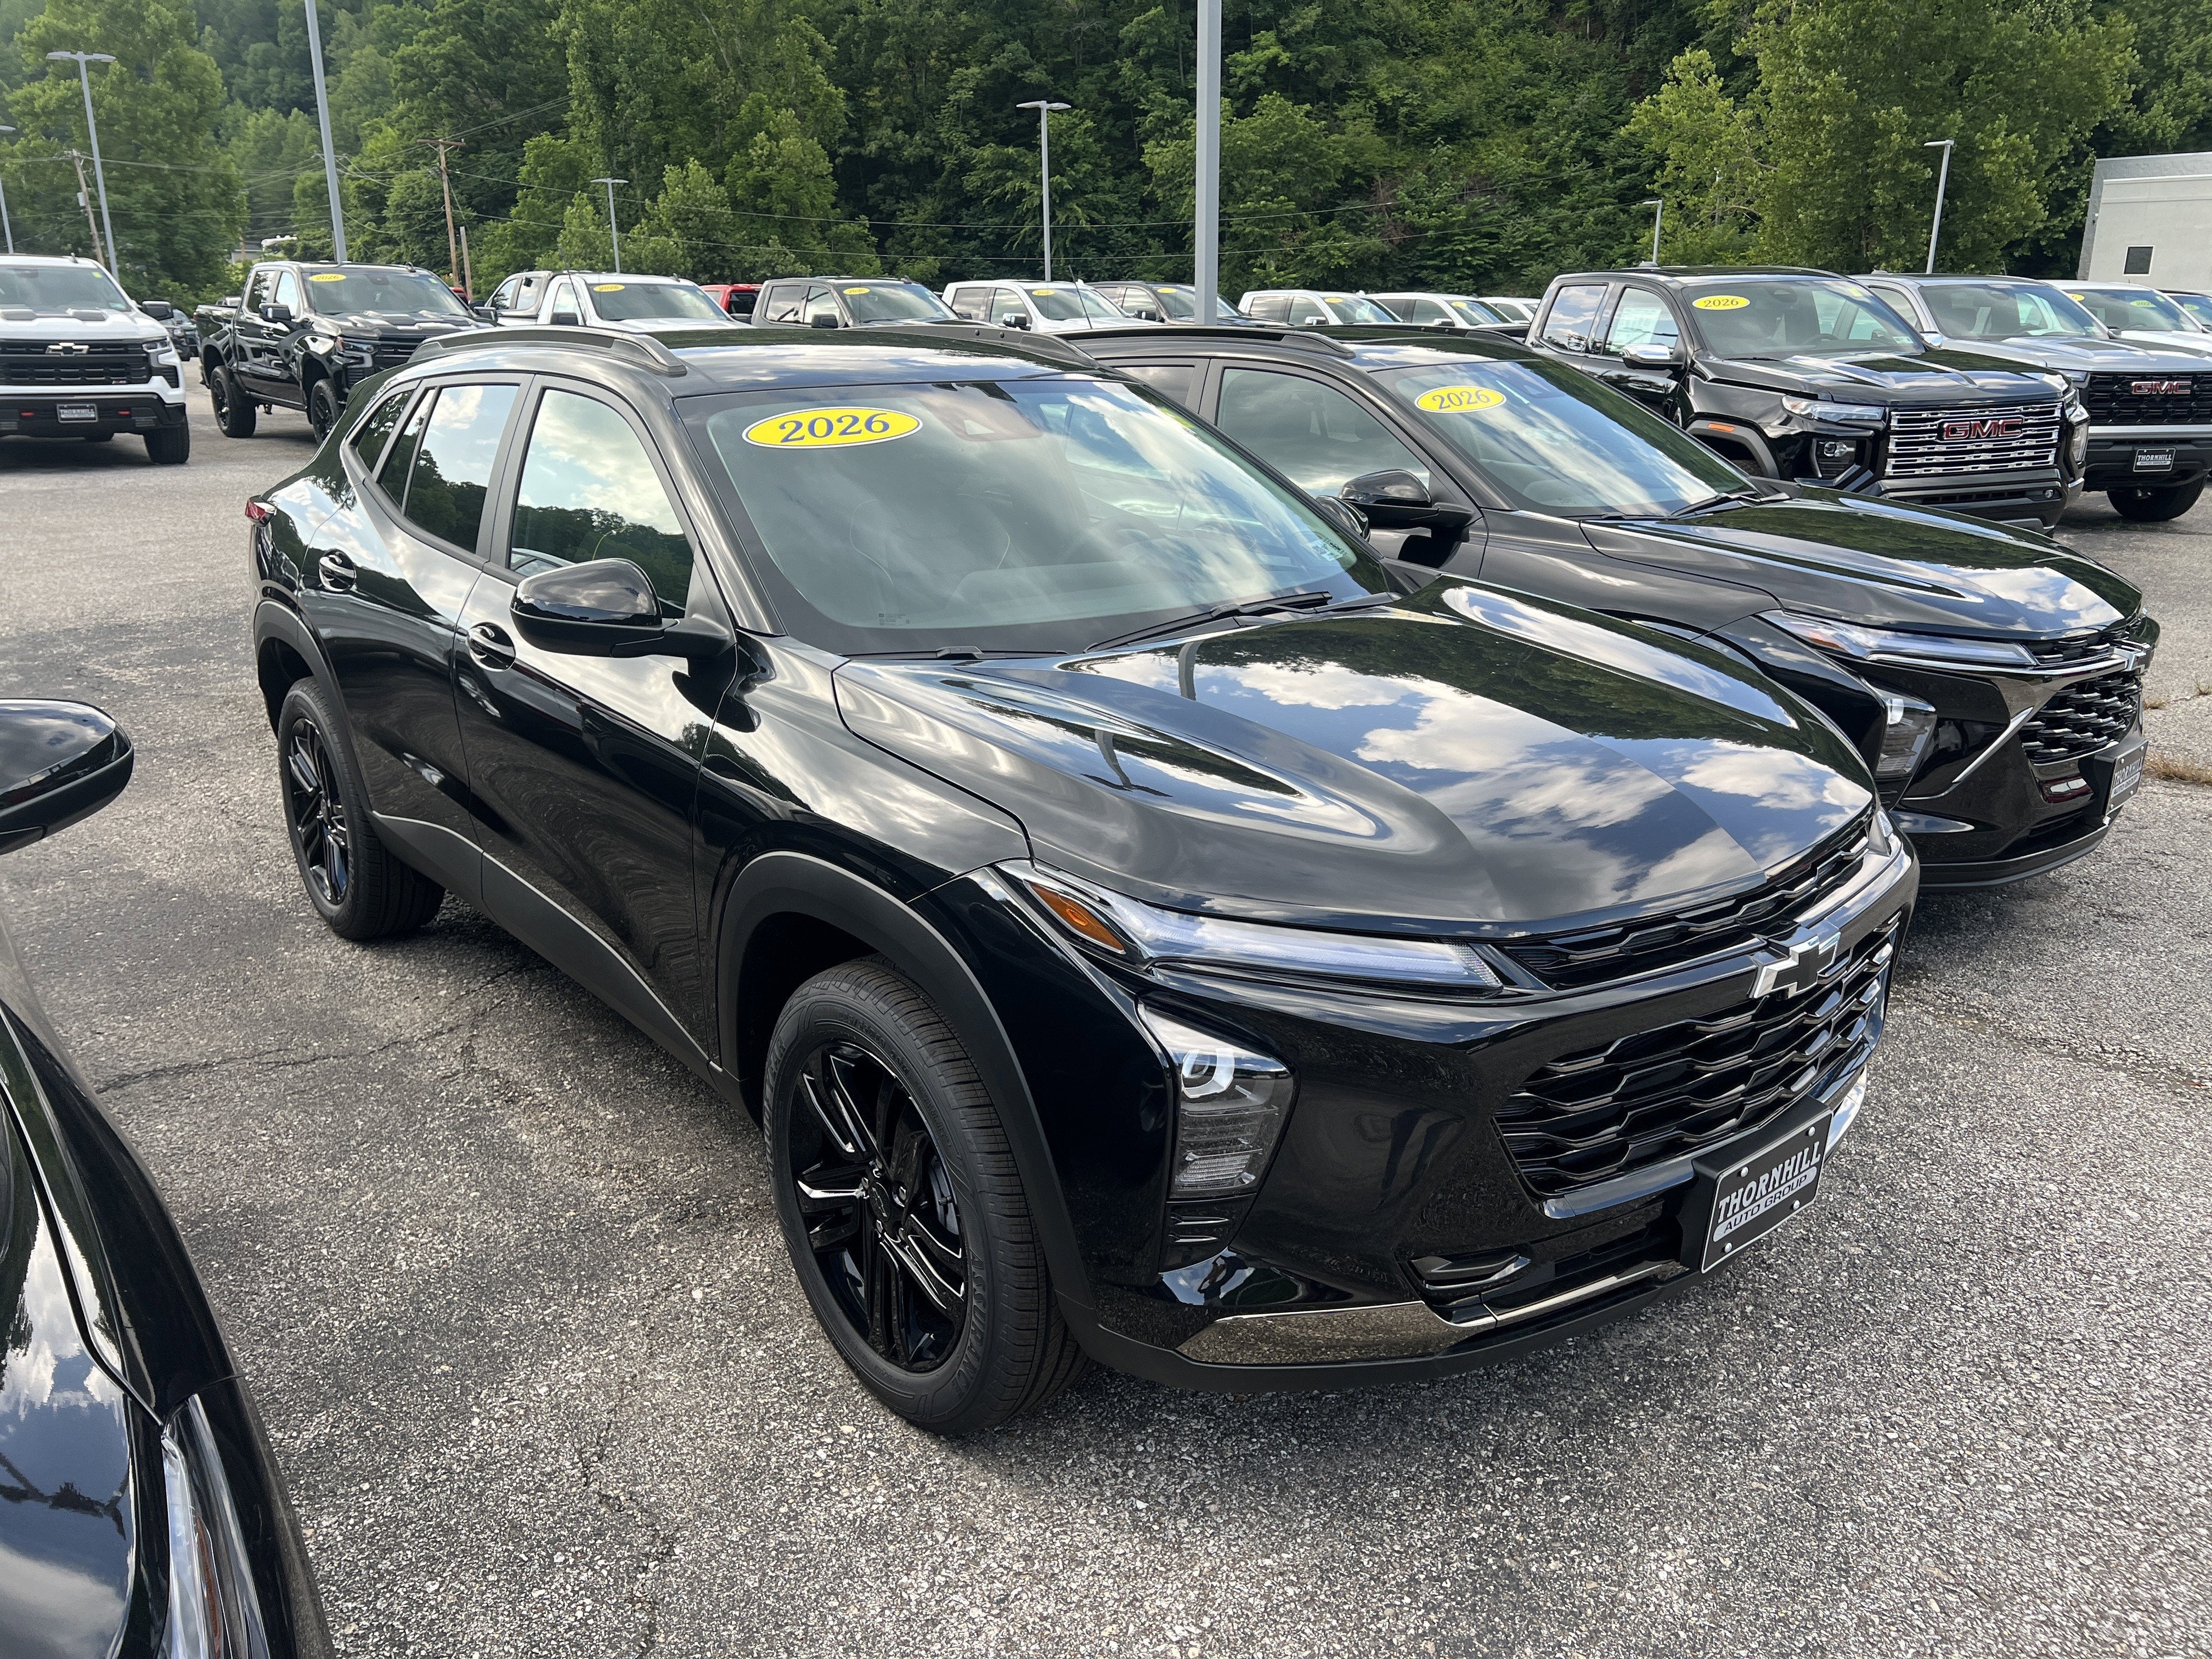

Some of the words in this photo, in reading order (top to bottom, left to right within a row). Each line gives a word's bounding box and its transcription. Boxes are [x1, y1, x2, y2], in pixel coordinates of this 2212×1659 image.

[1703, 298, 1739, 308] 2026
[1432, 390, 1491, 410] 2026
[2131, 381, 2192, 394] GMC
[779, 413, 890, 443] 2026
[1943, 419, 2023, 439] GMC
[1718, 1141, 1821, 1224] THORNHILL
[1724, 1204, 1760, 1233] AUTO
[1764, 1174, 1807, 1209] GROUP
[953, 1250, 987, 1400] ASSURANCE
